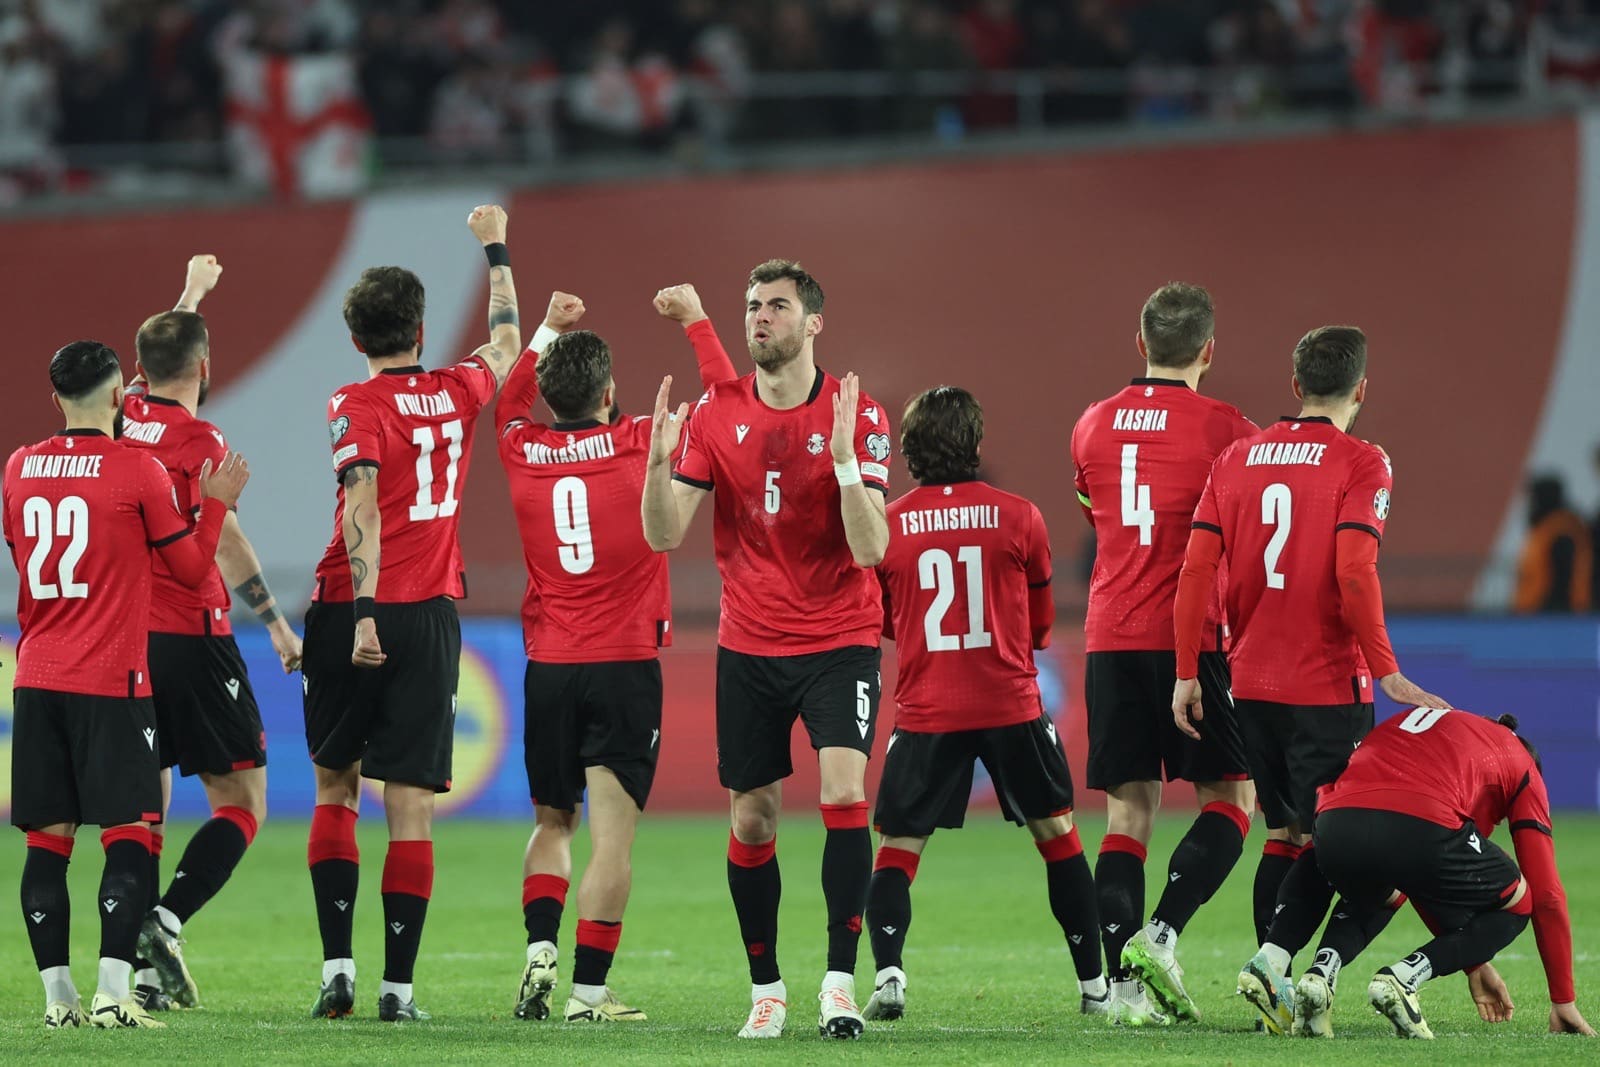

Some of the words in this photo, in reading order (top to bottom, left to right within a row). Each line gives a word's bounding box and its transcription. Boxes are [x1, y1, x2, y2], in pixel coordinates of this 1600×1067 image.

[1112, 408, 1168, 431] KASHIA
[20, 455, 103, 479] MIKAUTADZE
[408, 419, 464, 521] 11
[1246, 443, 1327, 467] KAKABADZE
[552, 476, 594, 574] 9
[765, 471, 781, 514] 5
[900, 505, 999, 536] TSITAISHVILI
[1121, 444, 1154, 545] 4
[23, 496, 89, 600] 22
[1261, 483, 1292, 589] 2
[918, 545, 992, 652] 21
[856, 680, 870, 720] 5
